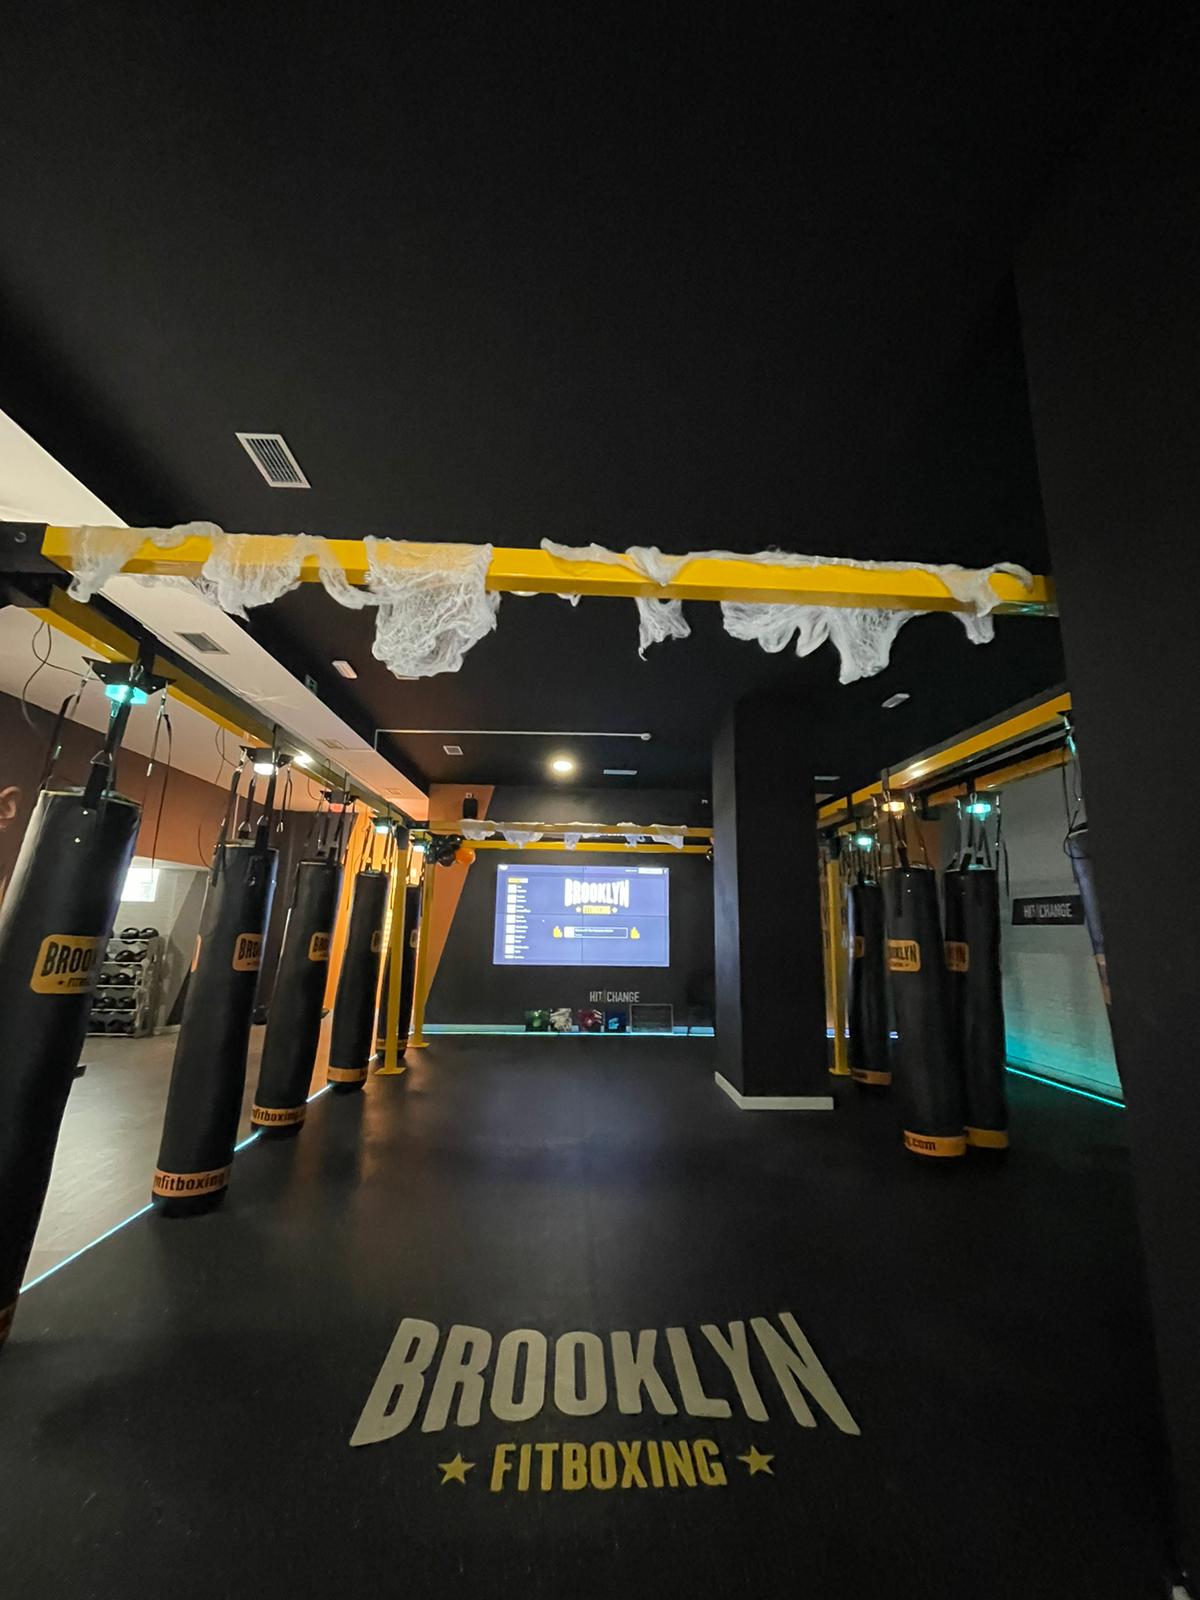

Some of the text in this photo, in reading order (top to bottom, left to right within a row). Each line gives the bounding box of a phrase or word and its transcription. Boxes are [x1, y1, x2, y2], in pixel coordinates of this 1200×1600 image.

[564, 878, 630, 908] BROOKLYN
[589, 991, 640, 1003] HIT CHANGE
[349, 1311, 862, 1447] BROOKLYN
[490, 1438, 728, 1492] FITBOXING
